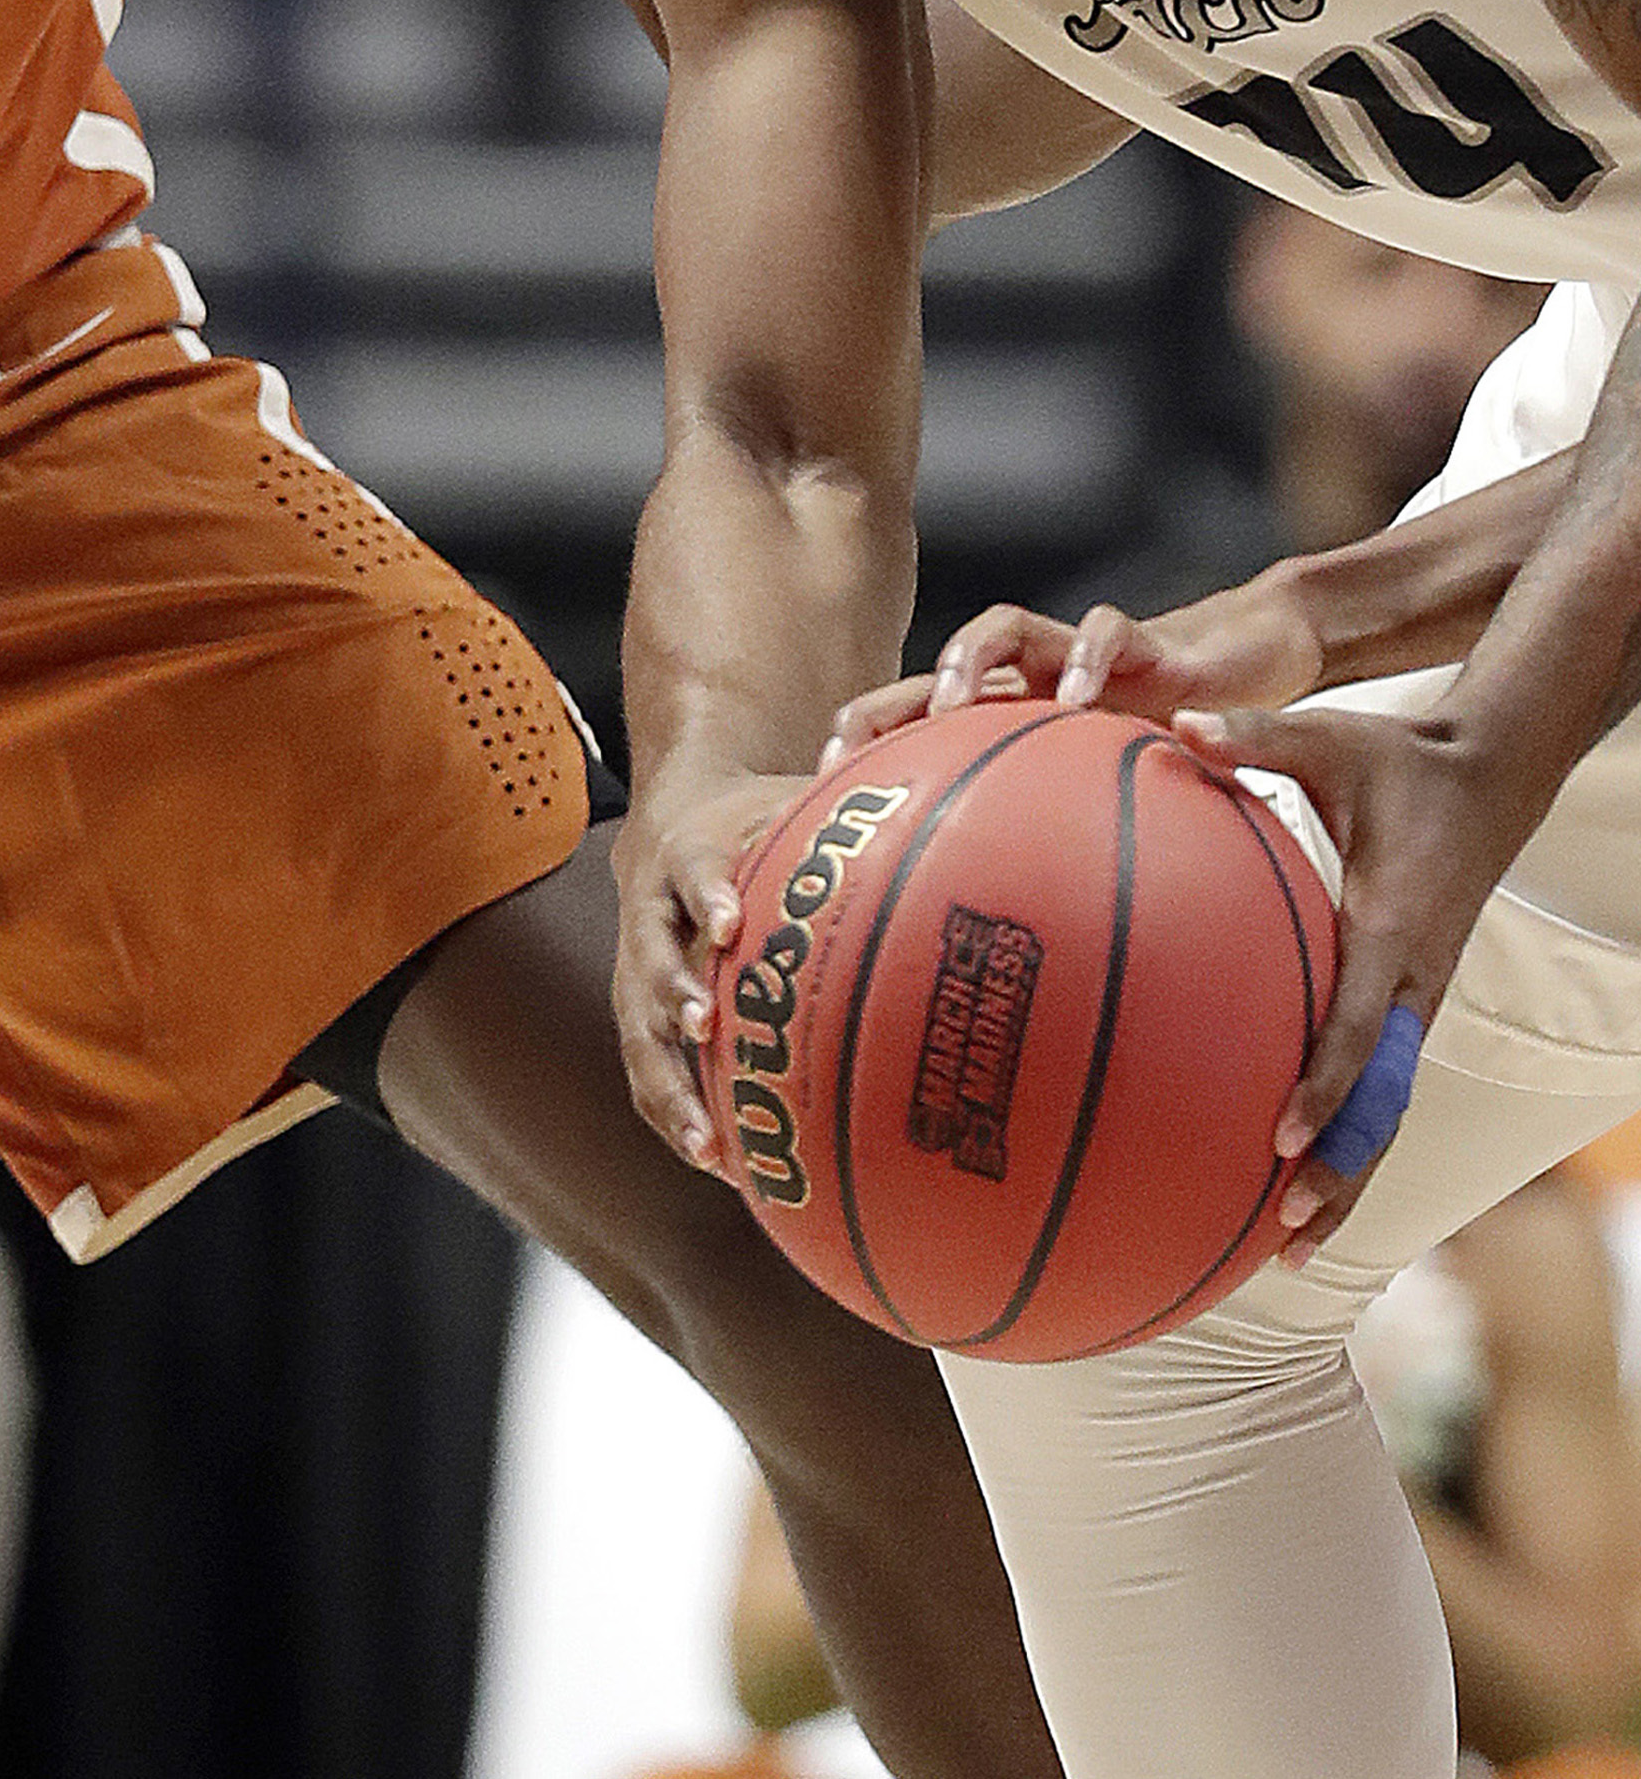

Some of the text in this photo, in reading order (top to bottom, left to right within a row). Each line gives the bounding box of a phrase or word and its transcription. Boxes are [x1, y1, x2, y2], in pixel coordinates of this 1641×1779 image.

[1164, 10, 1619, 213] 14
[733, 785, 909, 1206] Wilson
[919, 973, 977, 1112] MARCH
[959, 922, 1032, 1106] MADNESS
